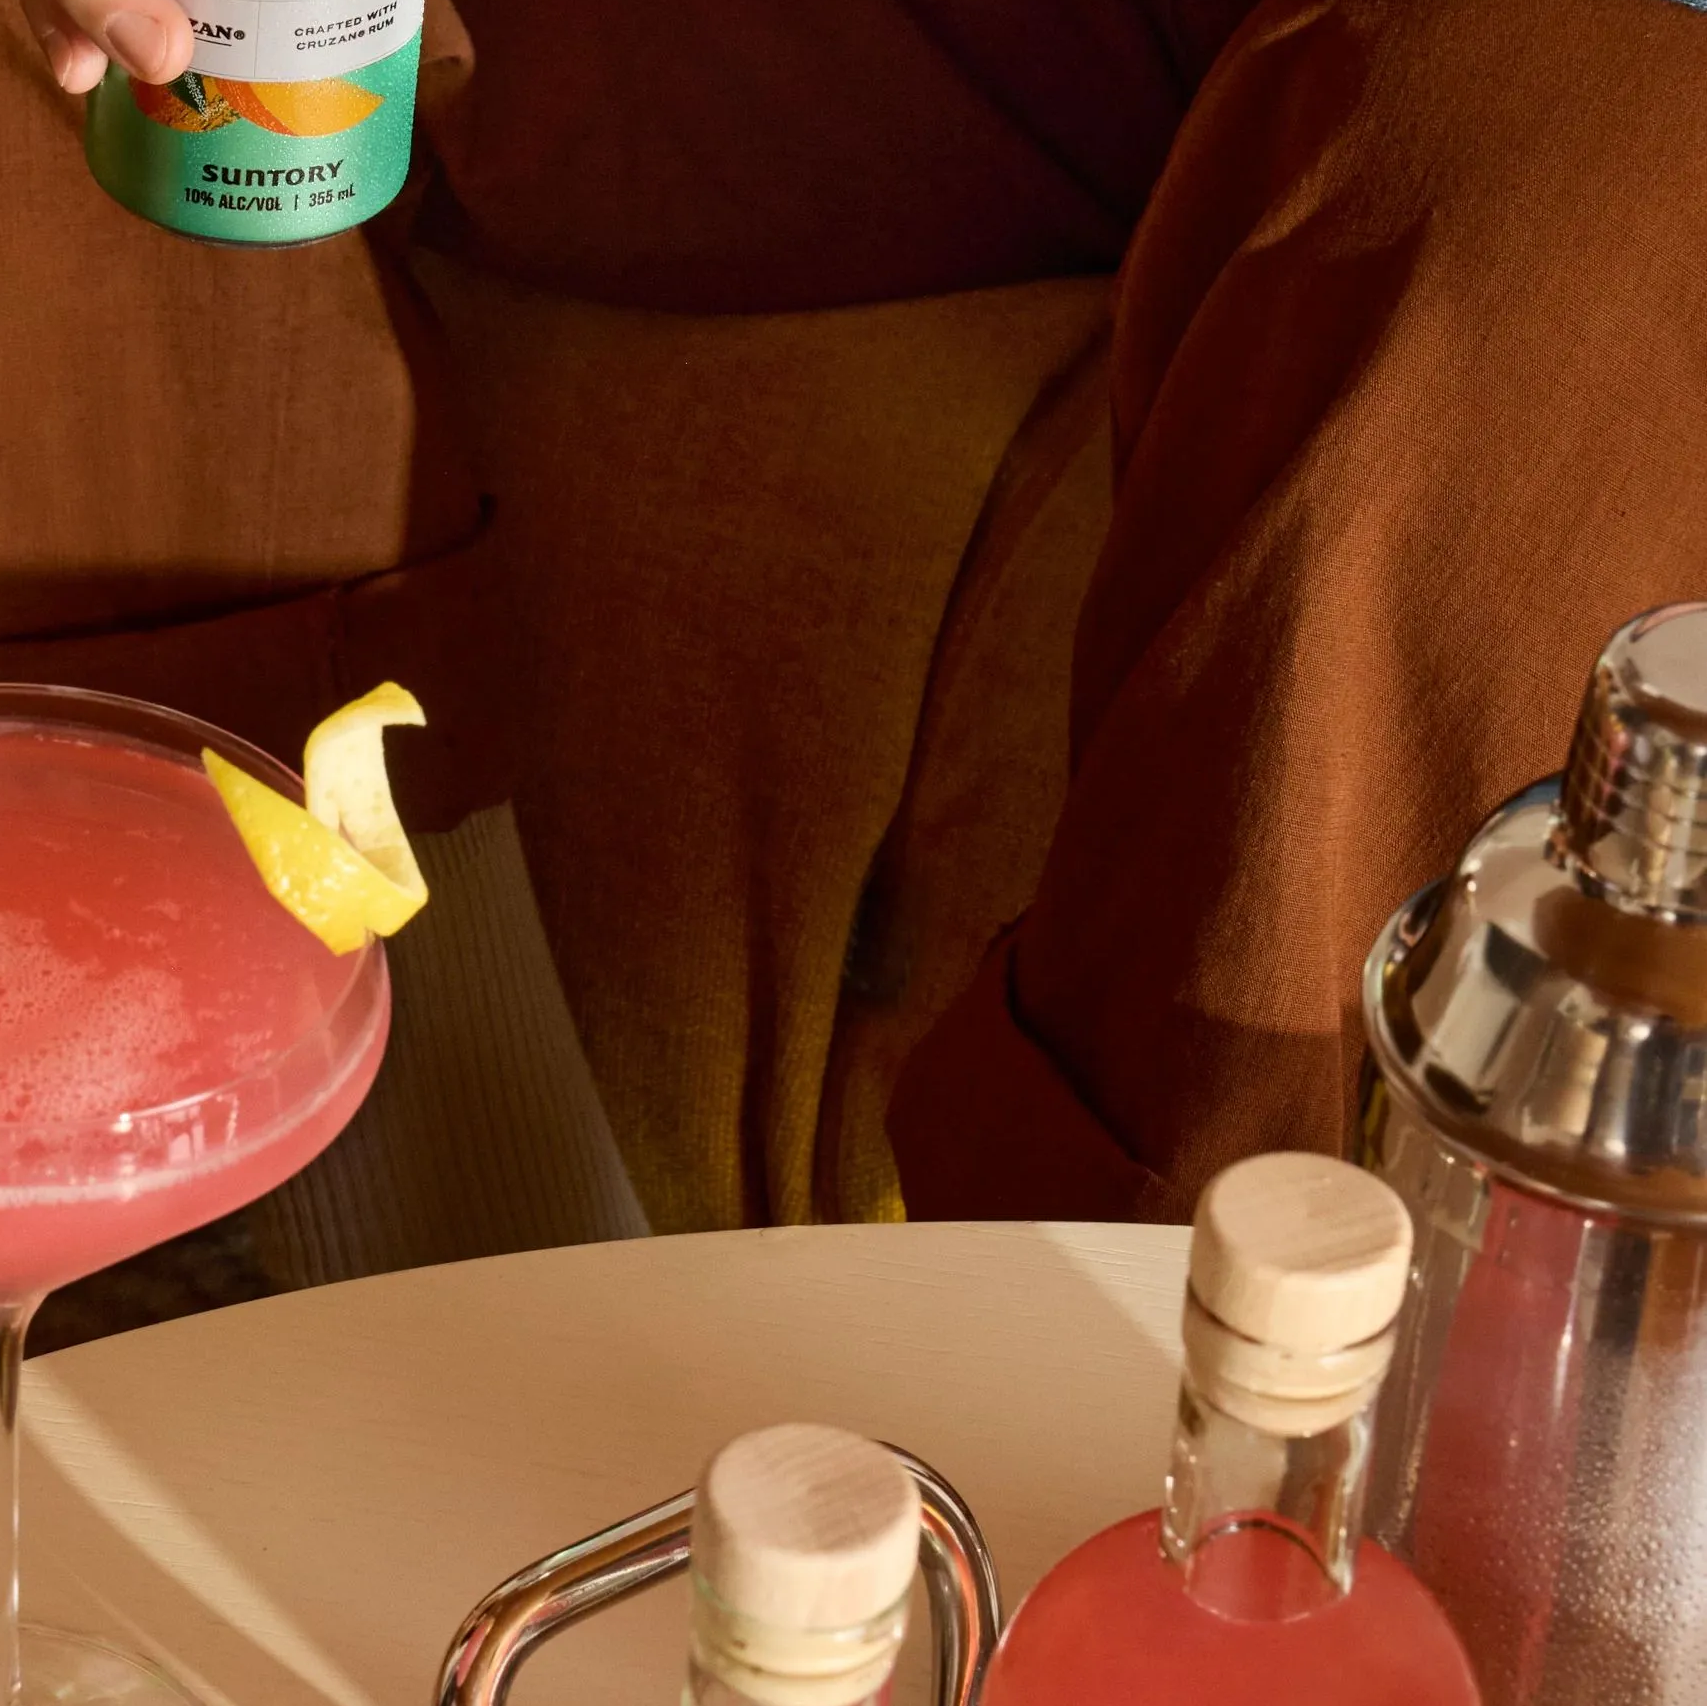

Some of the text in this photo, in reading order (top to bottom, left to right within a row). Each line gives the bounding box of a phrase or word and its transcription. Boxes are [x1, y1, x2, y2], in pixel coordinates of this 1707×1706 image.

[294, 0, 399, 38] CRAFTED WITH
[368, 16, 395, 36] RUM
[201, 159, 345, 187] SUNTORY
[184, 182, 357, 212] 10% ALC/VOL 355 mL
